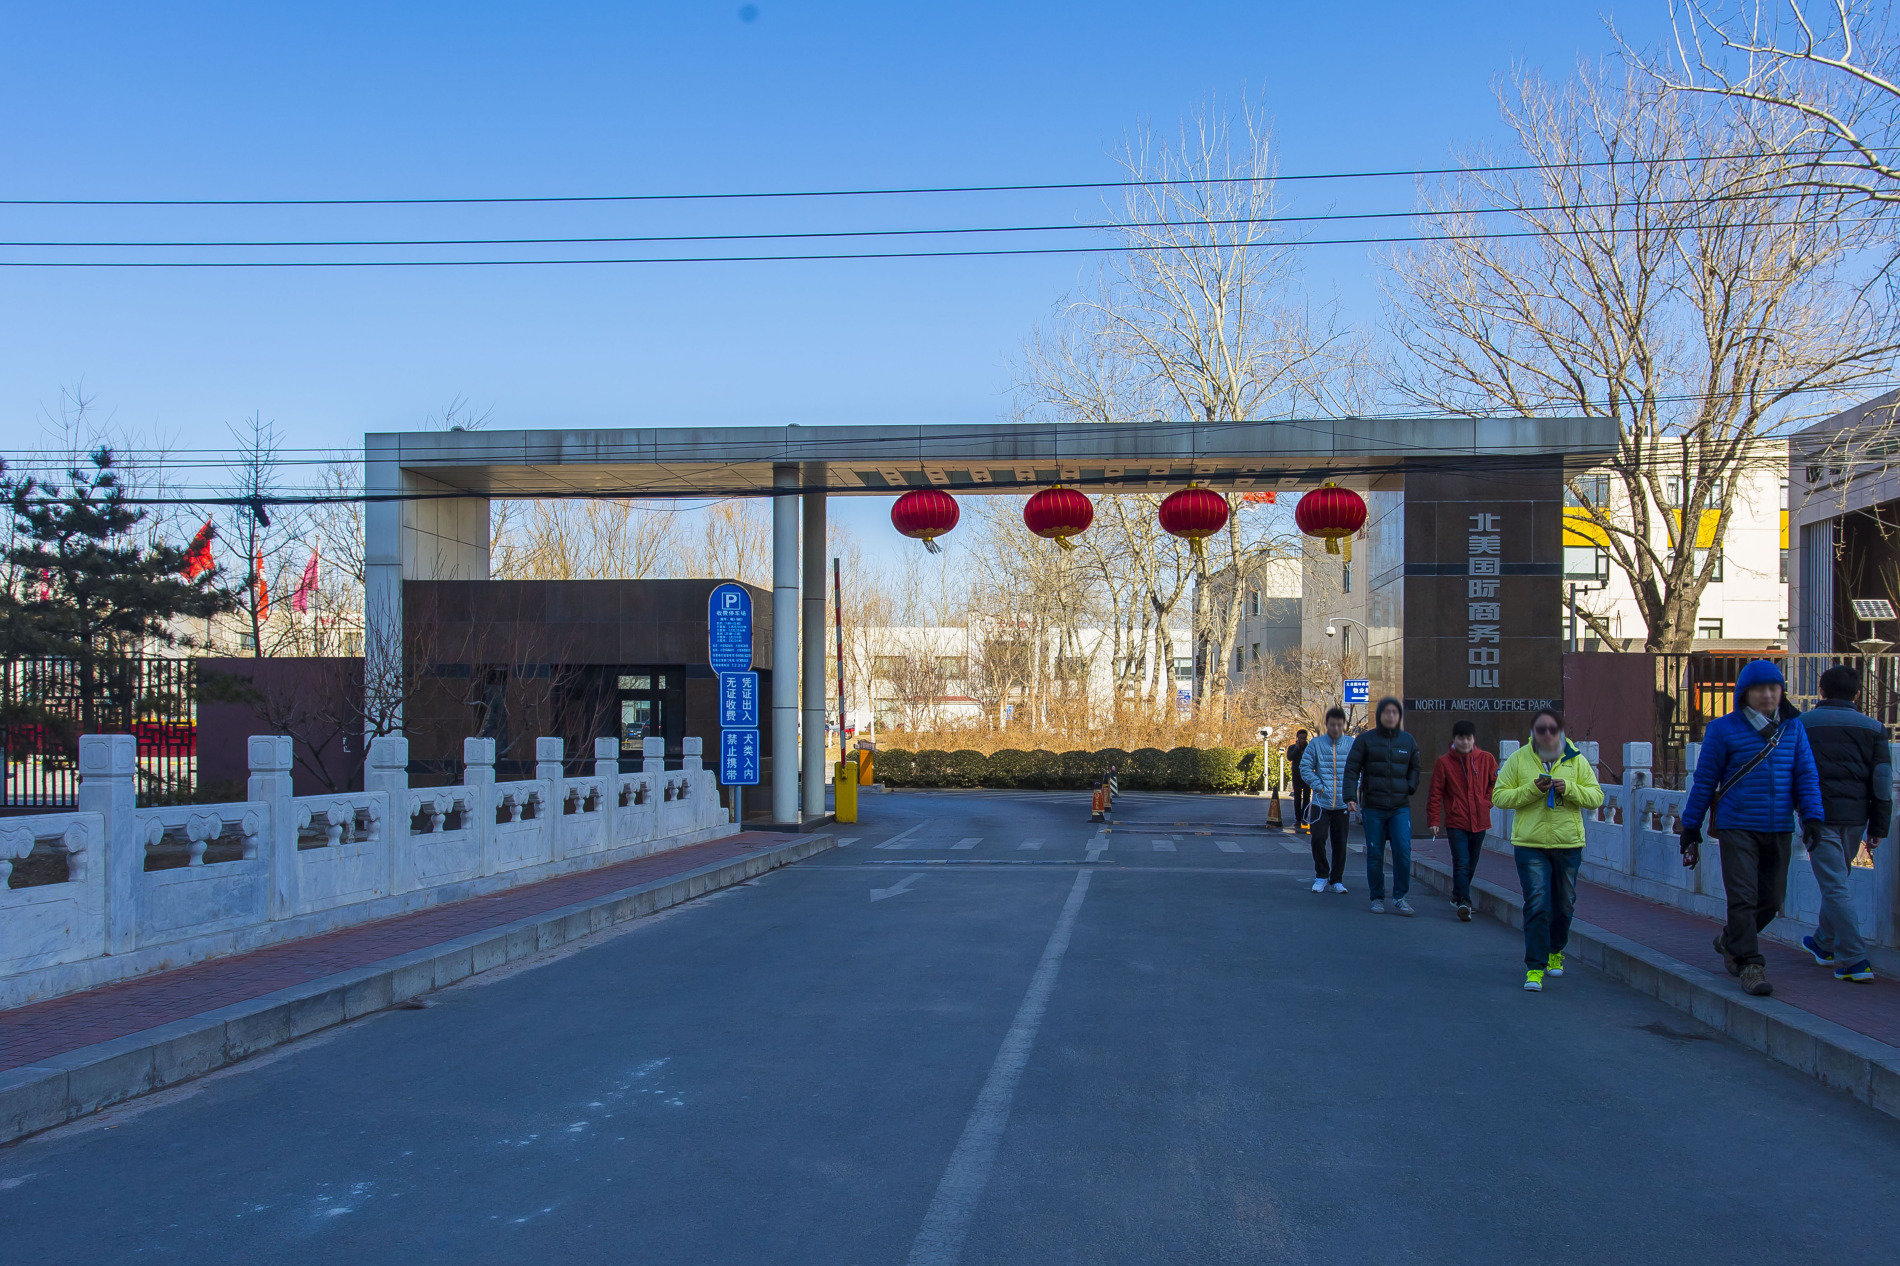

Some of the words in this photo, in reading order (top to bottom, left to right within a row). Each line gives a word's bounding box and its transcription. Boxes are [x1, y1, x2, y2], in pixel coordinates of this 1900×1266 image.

[725, 594, 738, 608] P
[1468, 512, 1501, 688] 北美国际商务中心
[725, 677, 737, 721] 无证收费
[741, 677, 752, 721] 凭证出入
[1415, 700, 1446, 711] NORTH
[1450, 700, 1490, 711] AMERICA
[1493, 700, 1526, 711] OFFICE
[1528, 700, 1552, 711] PARK
[726, 733, 738, 781] 禁止携带
[743, 733, 754, 780] 犬类入内
